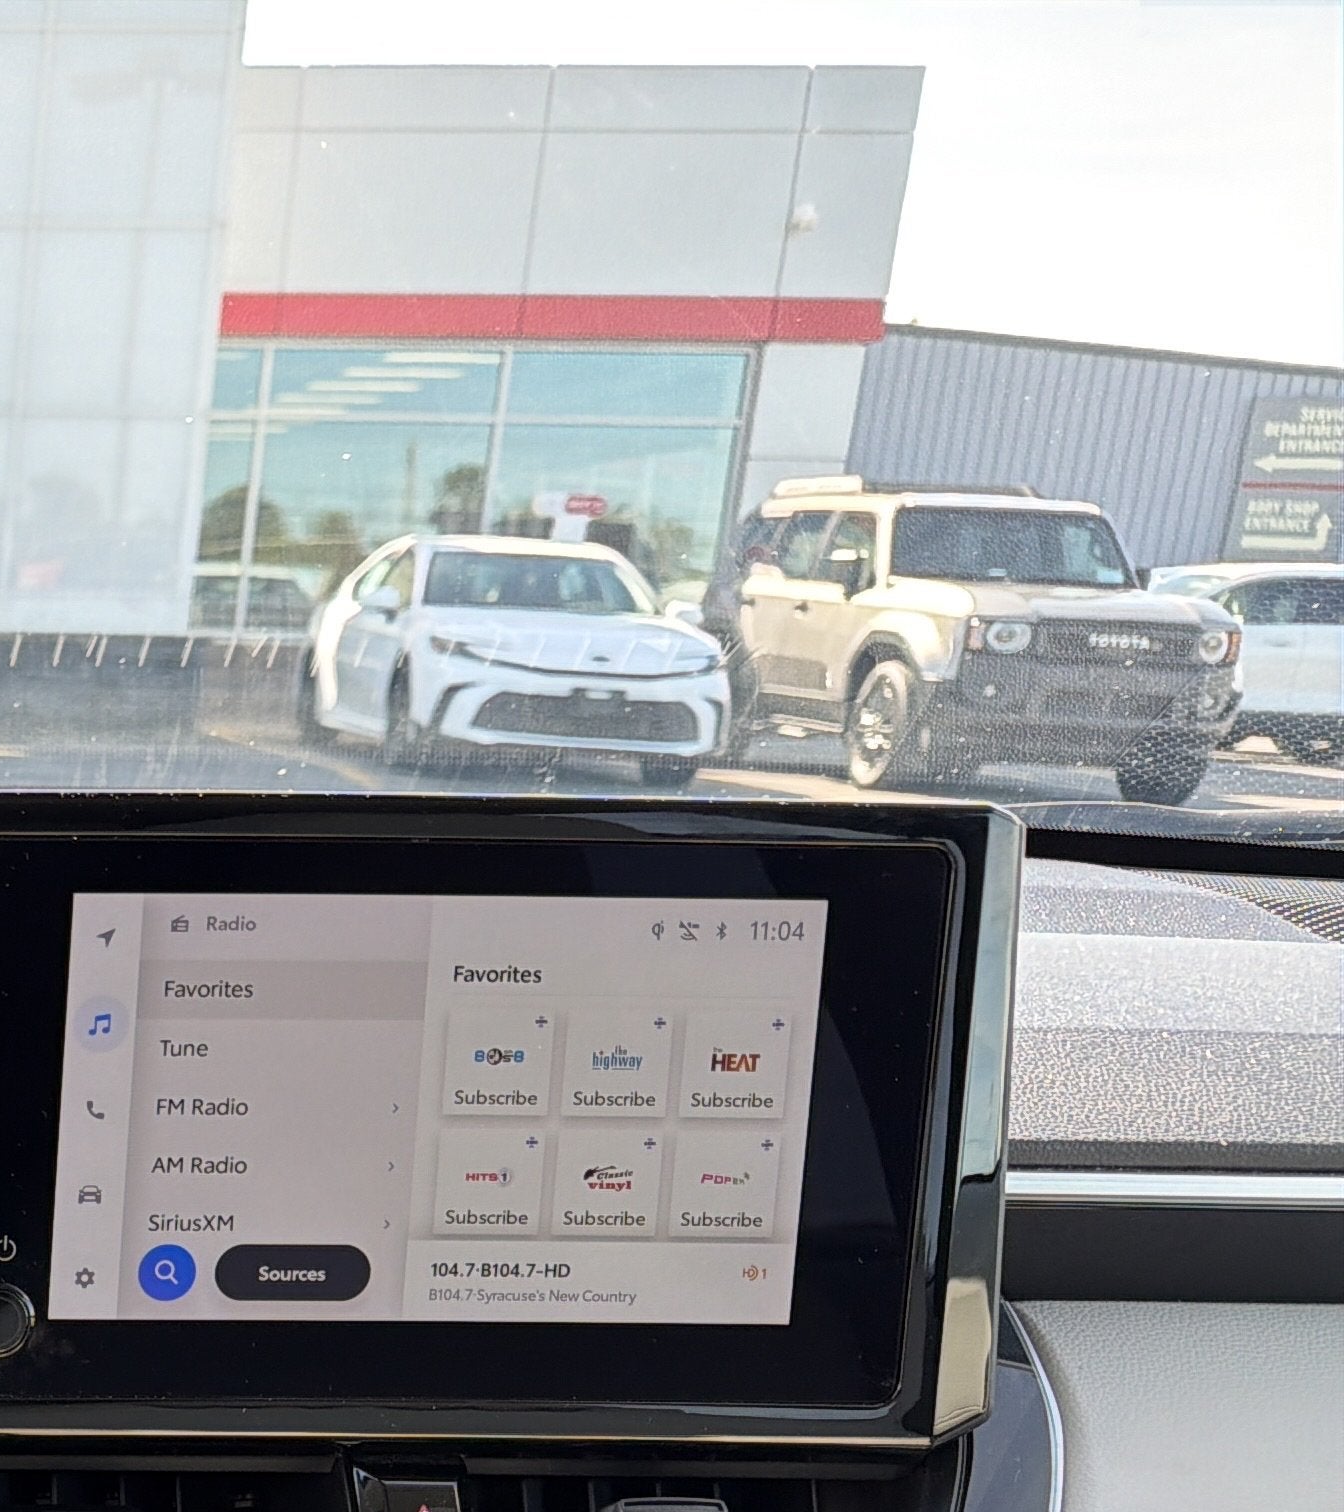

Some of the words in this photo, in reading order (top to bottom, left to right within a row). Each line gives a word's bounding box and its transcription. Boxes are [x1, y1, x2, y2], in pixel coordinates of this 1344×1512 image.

[206, 916, 257, 931] Radio
[750, 921, 805, 941] 11:04
[453, 965, 543, 983] Favorites
[164, 980, 254, 998] Favorites
[160, 1040, 209, 1057] Tune
[592, 1051, 643, 1071] highway
[710, 1054, 761, 1072] HEAT
[454, 1090, 538, 1106] Subscribe
[573, 1091, 656, 1107] Subscribe
[691, 1093, 774, 1109] Subscribe
[156, 1099, 185, 1115] FM
[192, 1098, 249, 1116] Radio
[151, 1157, 184, 1174] AM
[191, 1156, 248, 1174] Radio
[587, 1180, 632, 1192] vinyl
[148, 1214, 235, 1232] SiriusXM
[445, 1210, 529, 1226] Subscribe
[563, 1211, 646, 1227] Subscribe
[681, 1212, 763, 1228] Subscribe
[258, 1266, 327, 1282] Sources
[549, 1290, 579, 1302] New
[582, 1290, 637, 1304] Country
